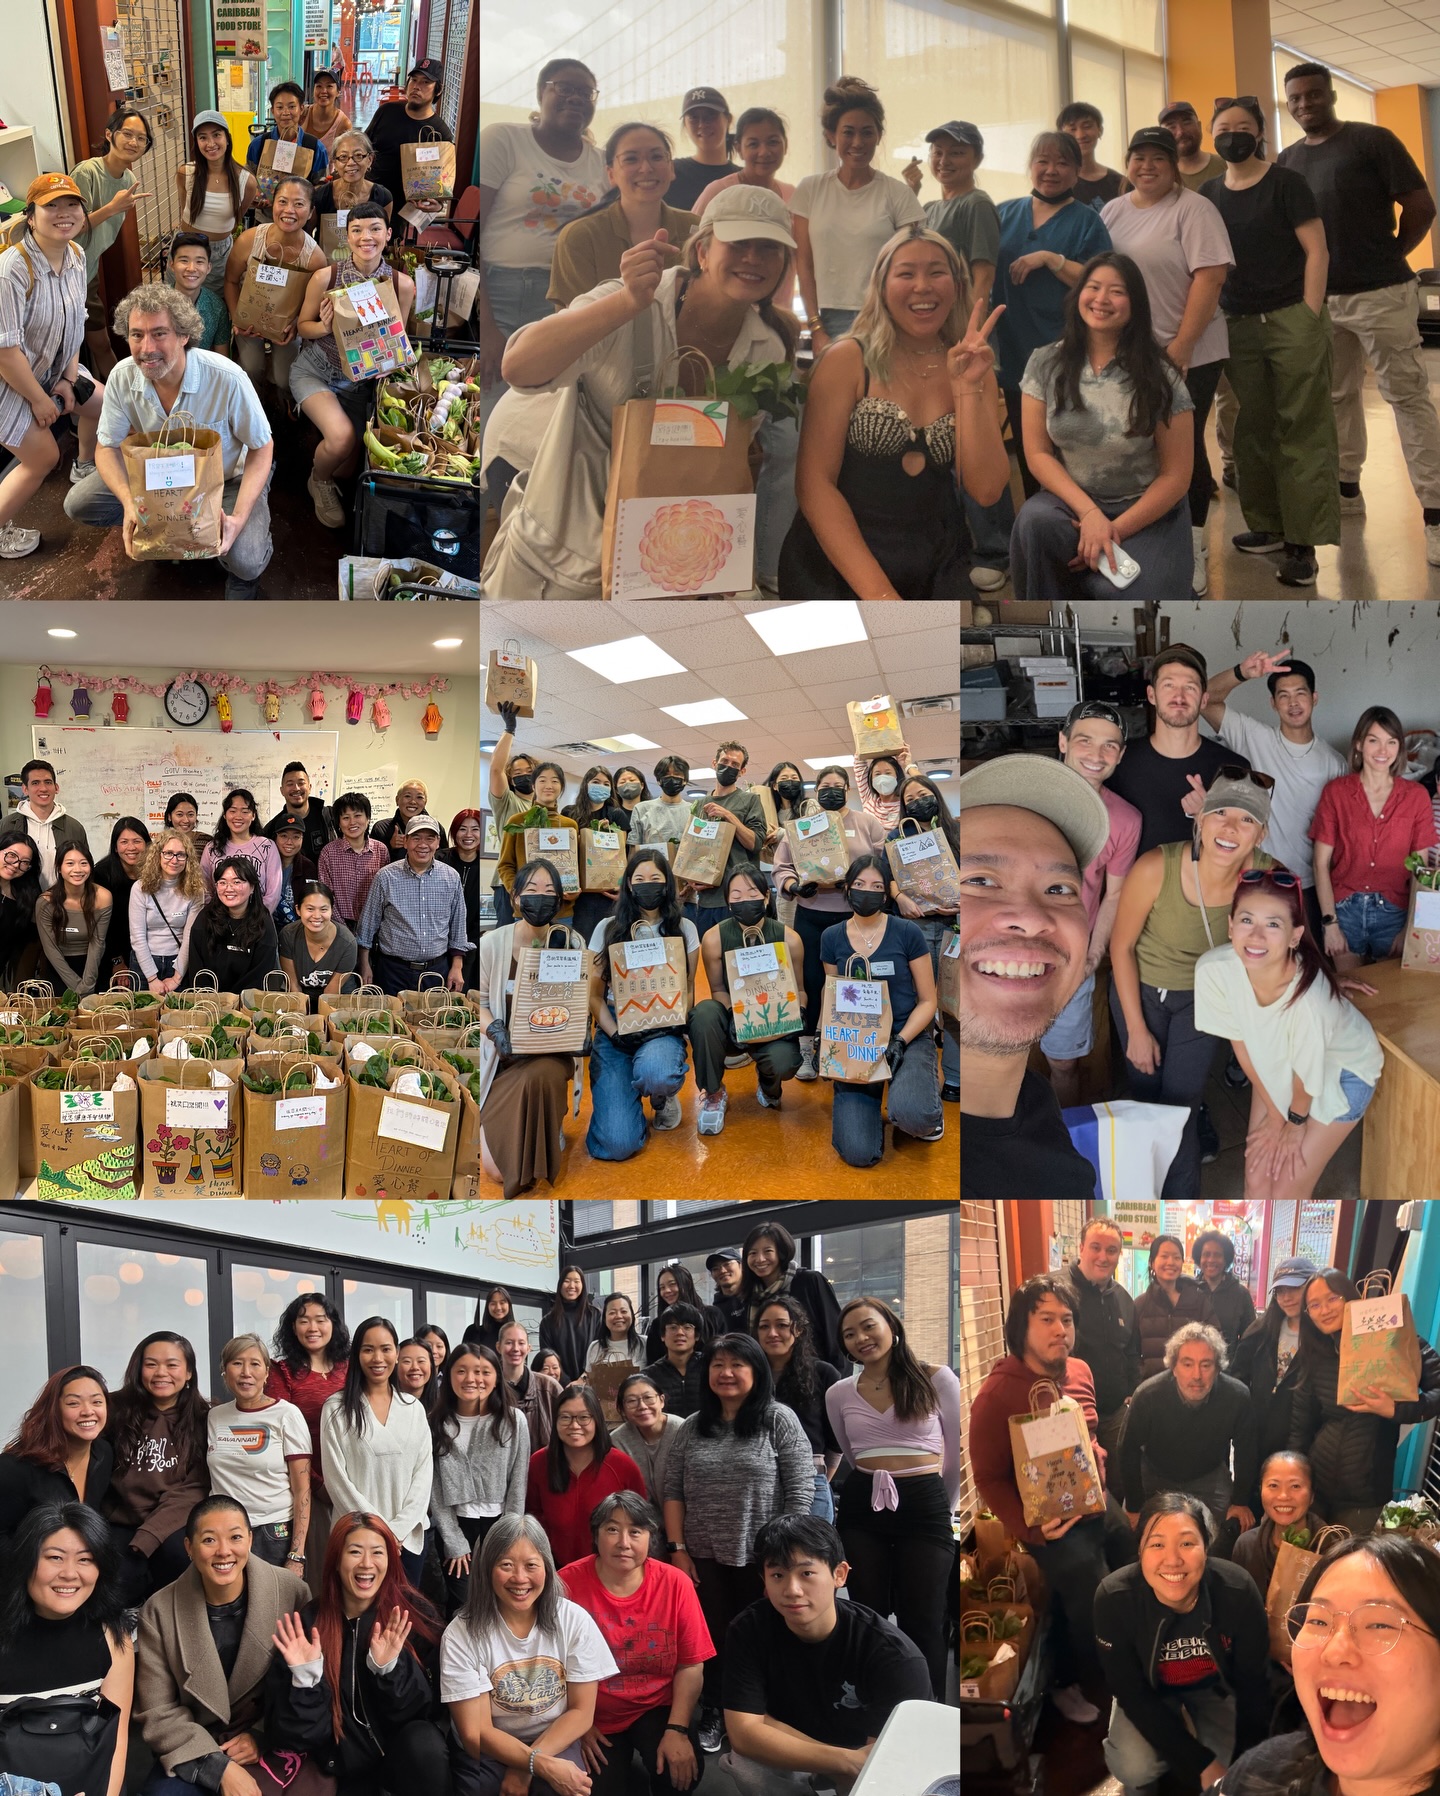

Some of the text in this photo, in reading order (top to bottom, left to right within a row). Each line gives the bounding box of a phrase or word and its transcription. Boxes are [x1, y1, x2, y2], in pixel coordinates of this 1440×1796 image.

[217, 8, 260, 17] CARIBBEAN
[216, 21, 261, 30] FOOD STORE
[692, 90, 706, 100] NY
[748, 196, 770, 218] NY
[343, 327, 363, 337] HEART
[154, 489, 183, 497] HEART
[746, 981, 779, 996] DINNER
[825, 1025, 877, 1045] HEART of
[368, 1131, 436, 1162] HEART OF
[378, 1155, 424, 1176] DINNER
[209, 1180, 234, 1188] HEART
[1115, 1201, 1156, 1211] CARIBBEAN
[1114, 1214, 1157, 1224] FOOD STORE
[529, 1685, 567, 1700] Canyon
